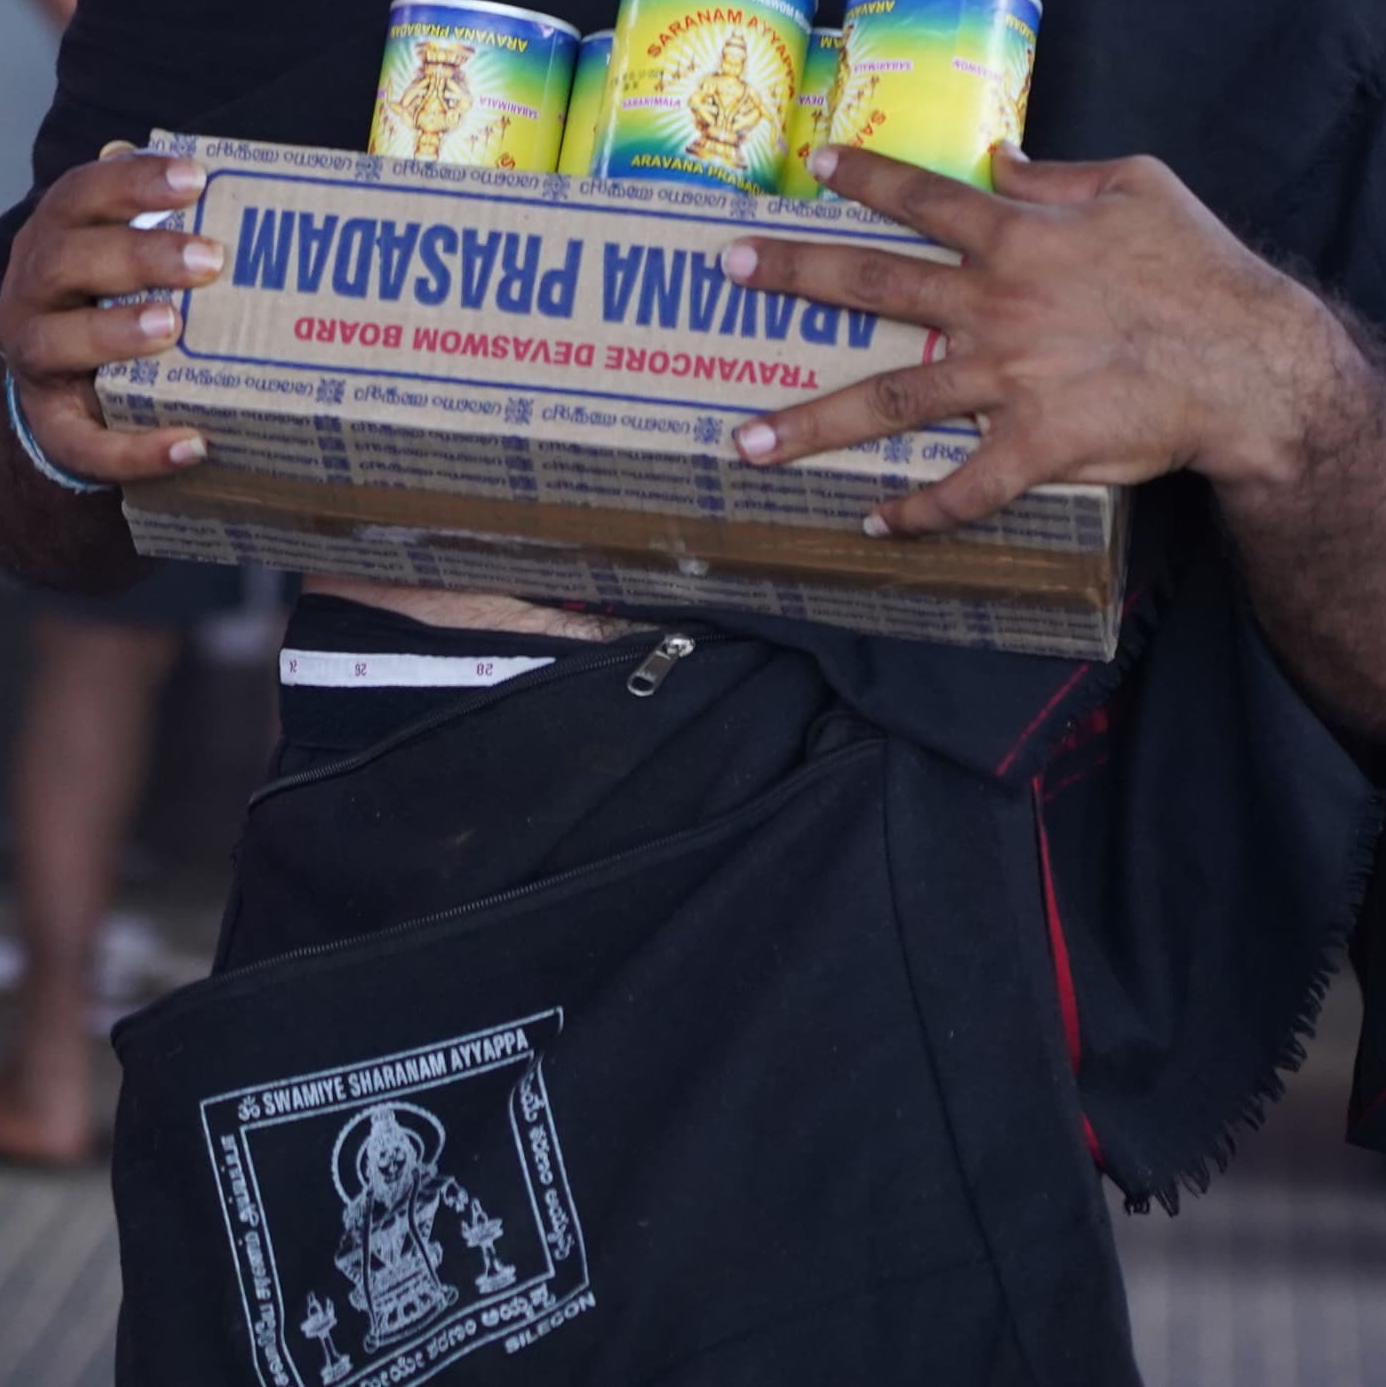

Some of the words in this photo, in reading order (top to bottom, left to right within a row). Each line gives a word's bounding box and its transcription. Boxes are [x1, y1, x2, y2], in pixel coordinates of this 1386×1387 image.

[454, 27, 529, 54] ARAVANA
[646, 7, 744, 59] SARANAM
[746, 15, 796, 100] AYYAPPA
[630, 154, 704, 175] ARAVANA
[231, 205, 585, 319] PRASADAM
[293, 316, 404, 349] BOARD
[413, 326, 596, 368] DEVASWOM
[604, 345, 820, 390] TRAVANCORE
[262, 1079, 345, 1116] SWAMIYE
[350, 1053, 448, 1098] SHARANAM
[450, 1027, 530, 1073] AYYAPPA
